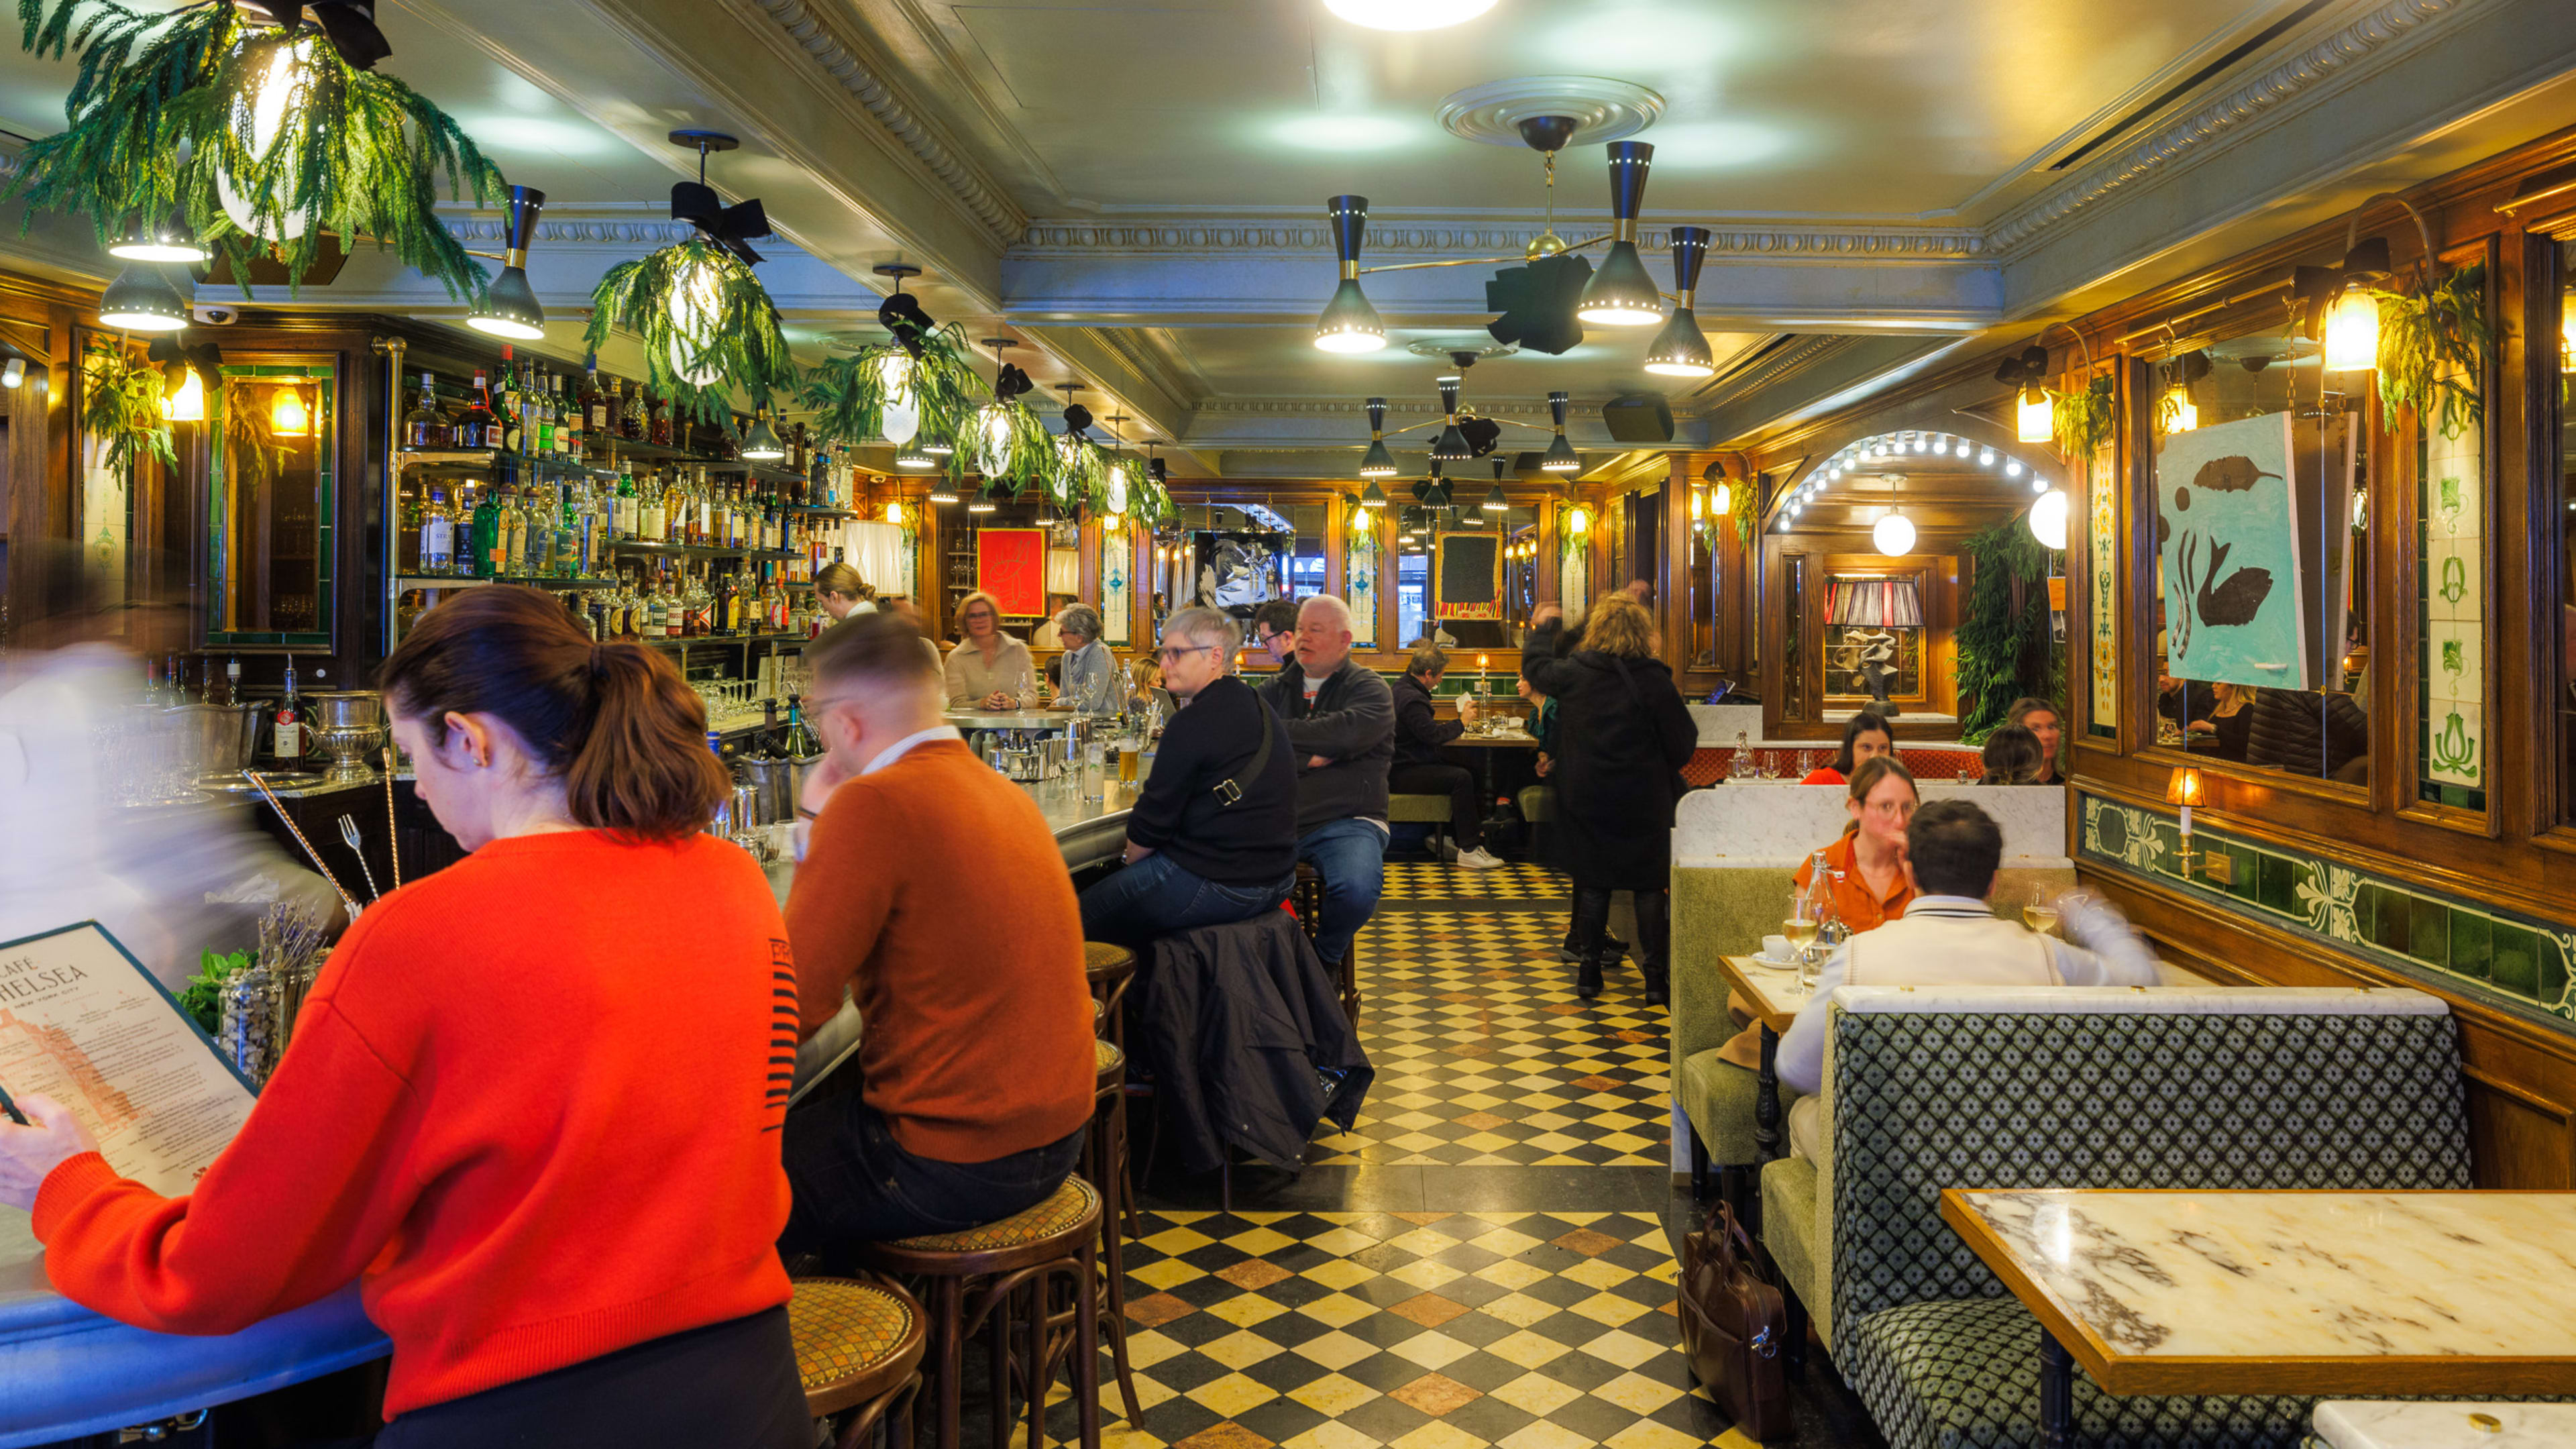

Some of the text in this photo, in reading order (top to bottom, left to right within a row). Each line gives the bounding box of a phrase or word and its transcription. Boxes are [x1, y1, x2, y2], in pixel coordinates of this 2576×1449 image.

[0, 965, 88, 1002] HELSEA
[15, 1000, 34, 1008] NEW
[36, 993, 58, 1002] YORK
[60, 987, 78, 995] CITY
